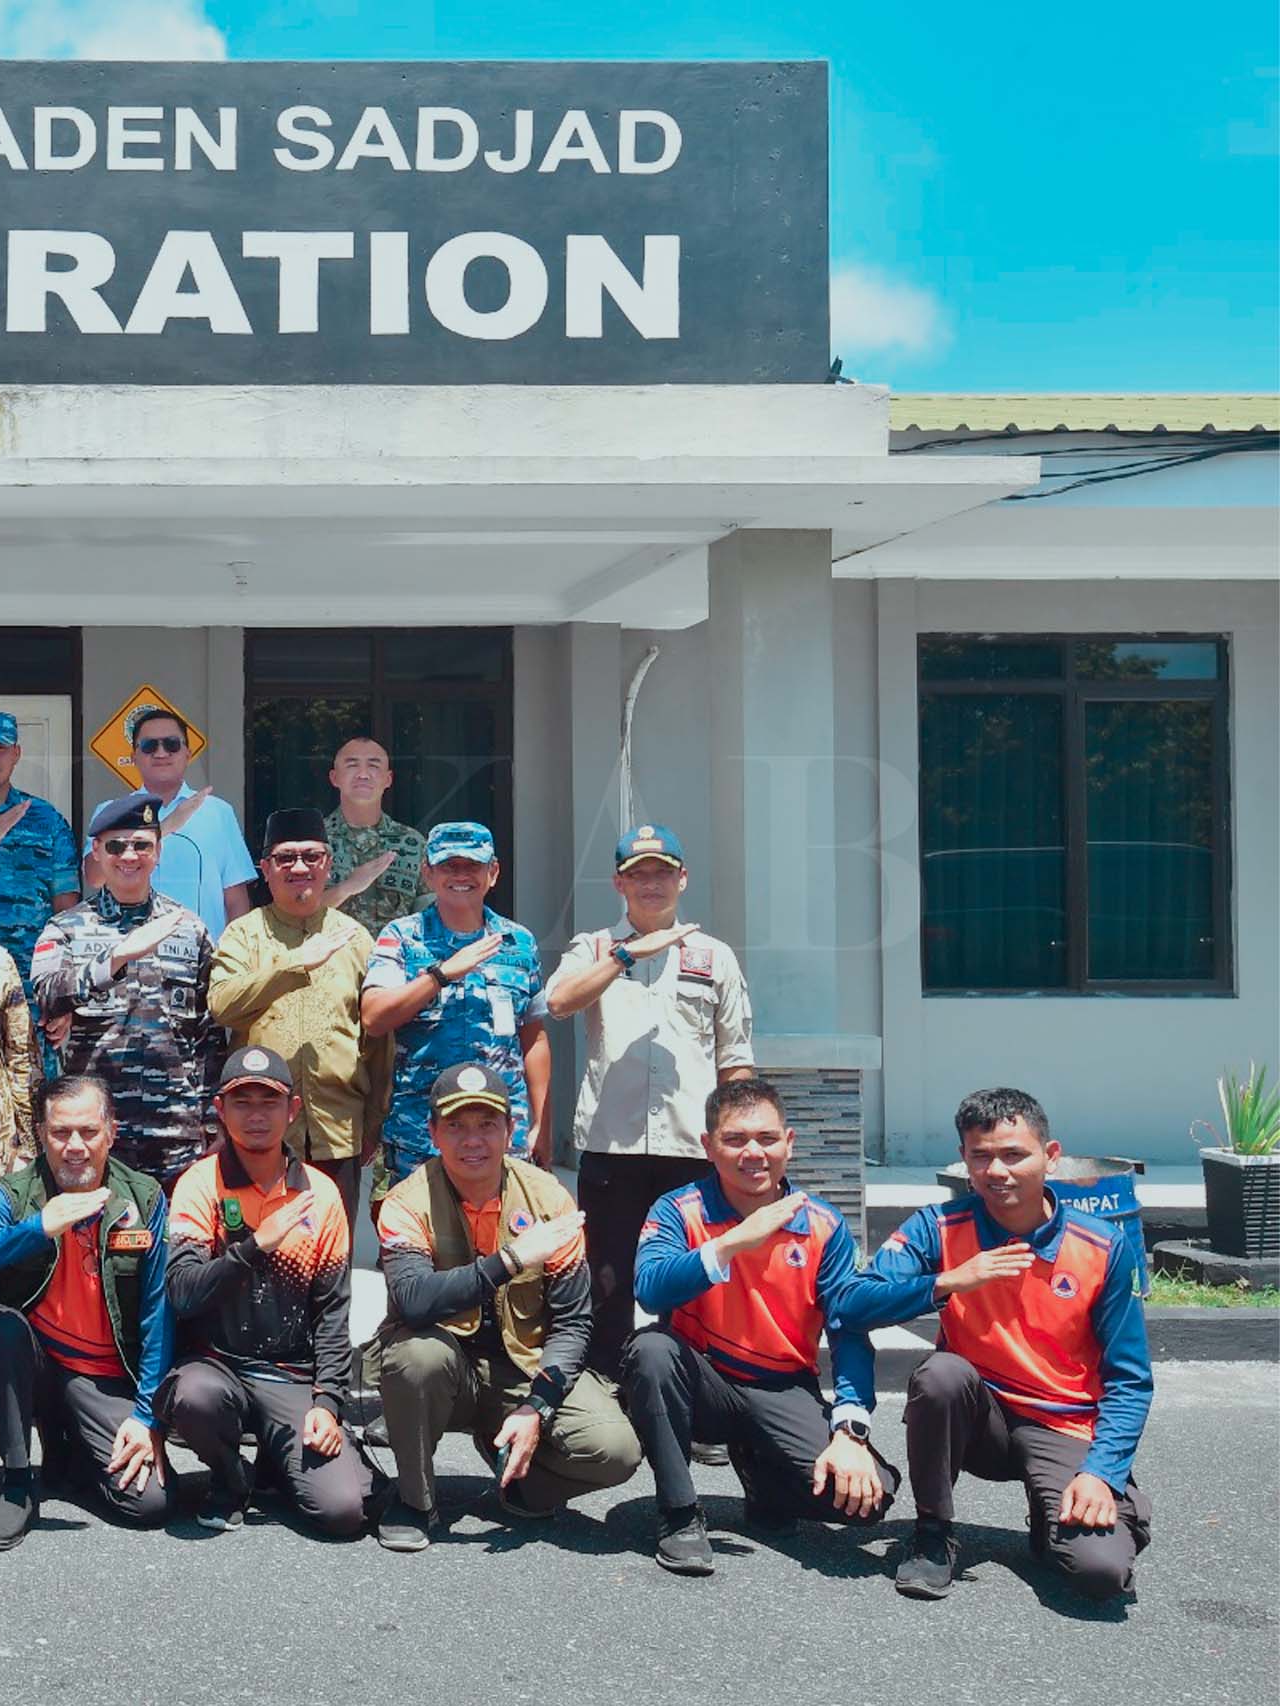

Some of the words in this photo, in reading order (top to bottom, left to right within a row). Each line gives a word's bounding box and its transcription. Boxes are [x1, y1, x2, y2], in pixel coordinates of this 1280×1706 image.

[274, 106, 683, 174] SADJAD
[163, 943, 180, 954] TNI
[183, 946, 196, 958] AL
[1060, 1193, 1119, 1213] MPAT
